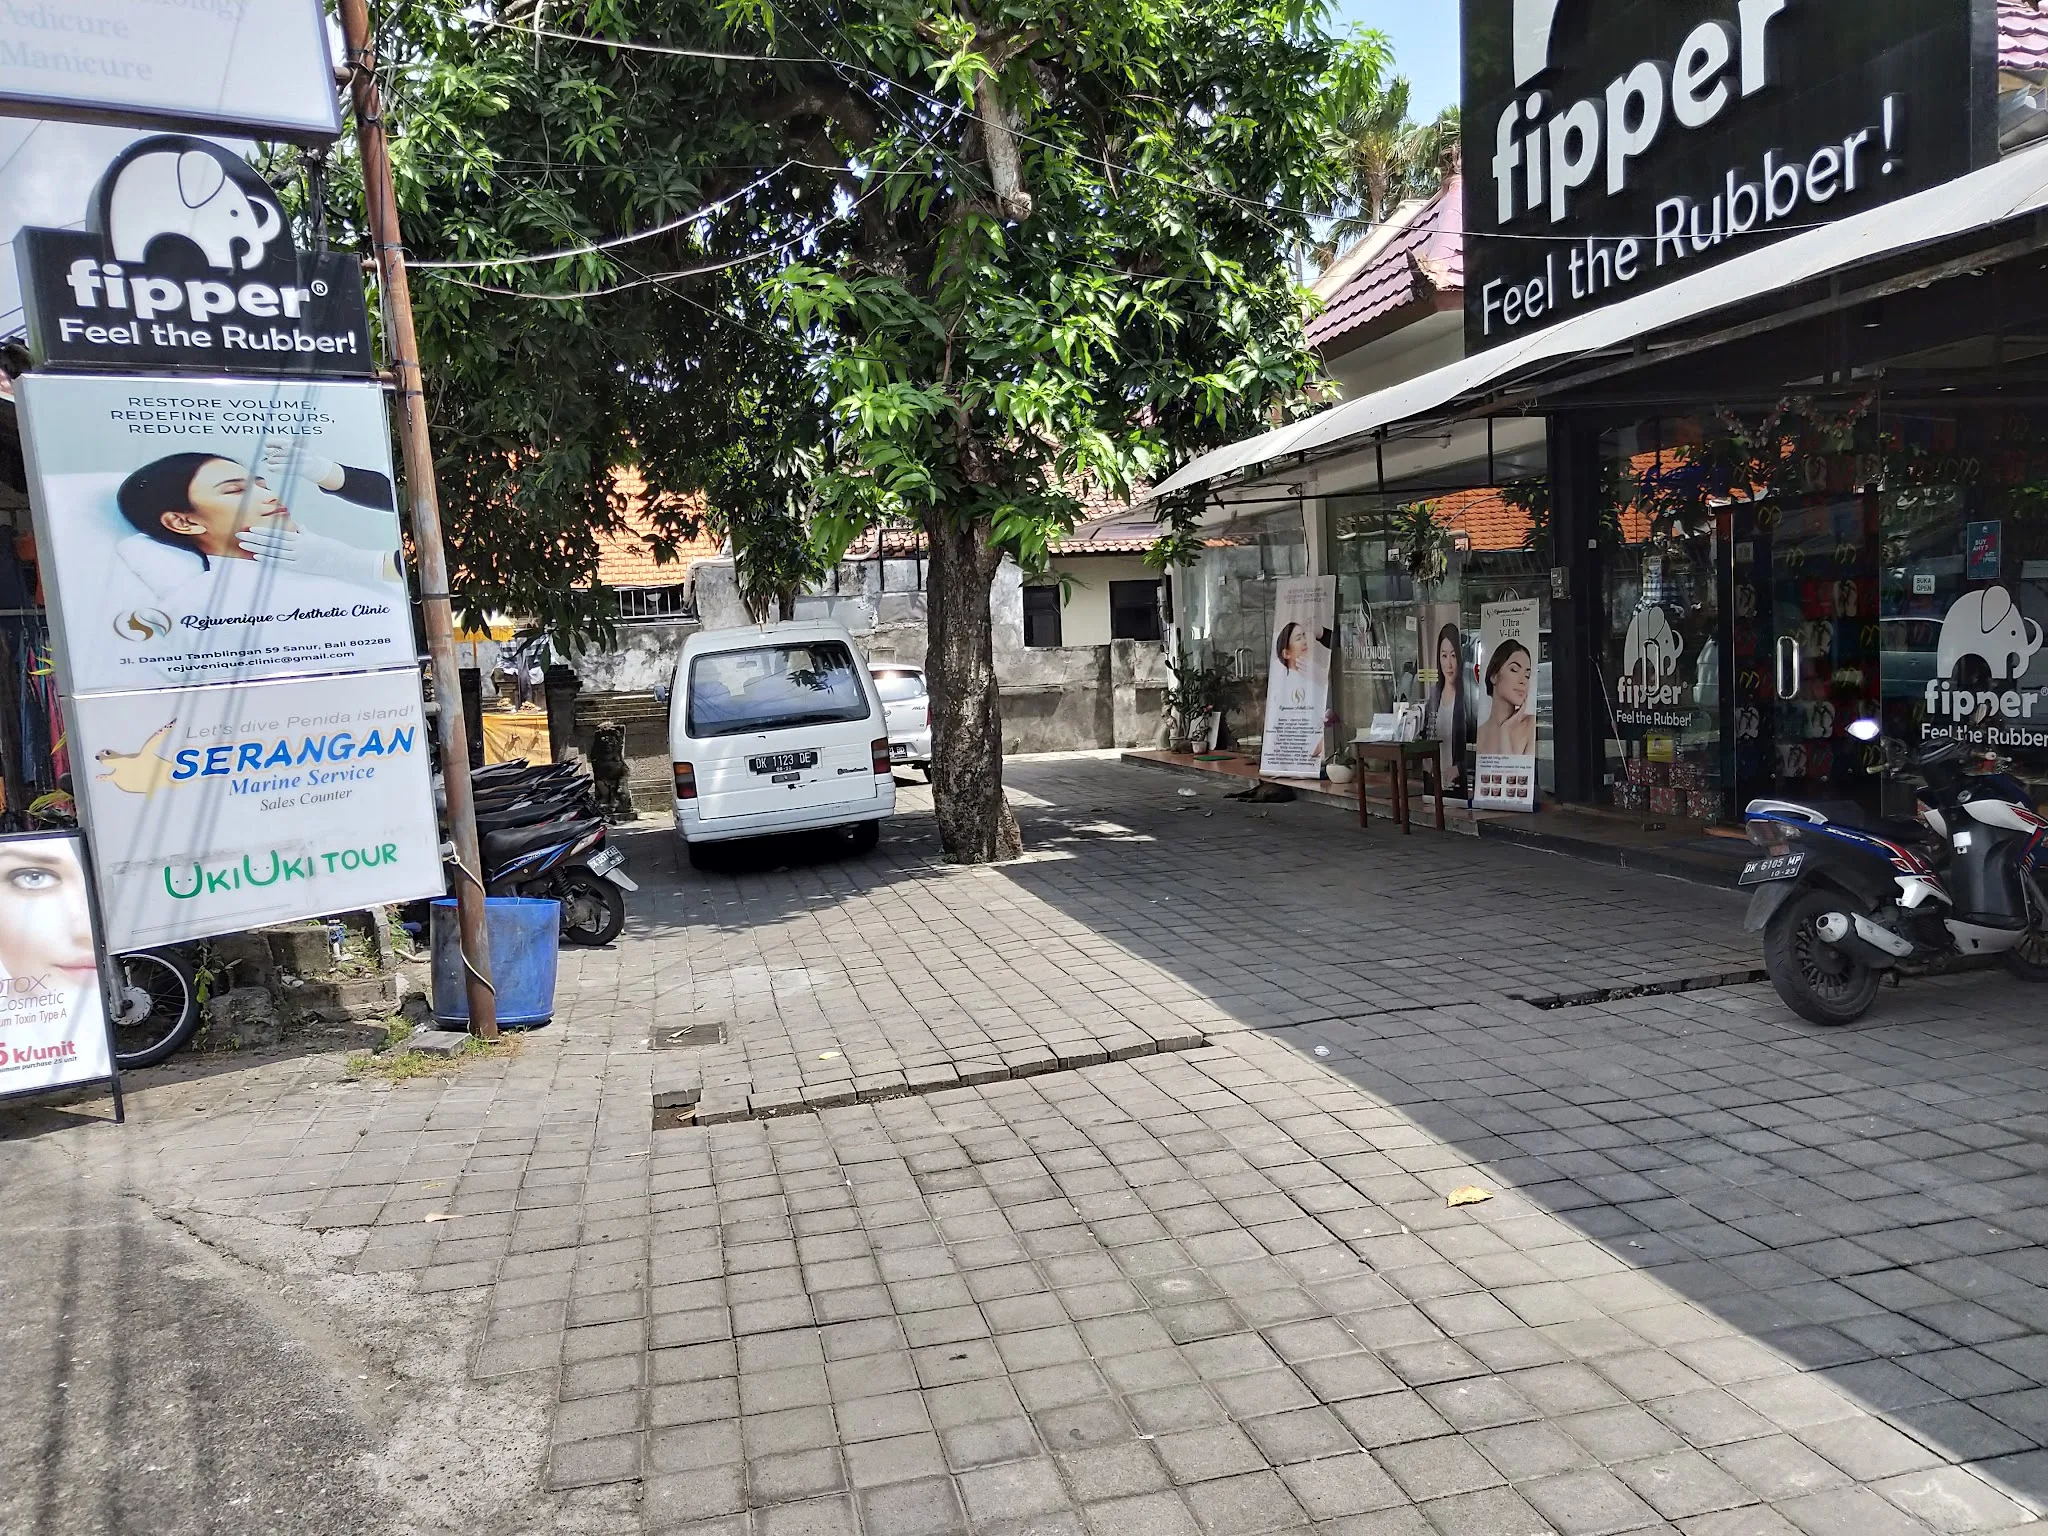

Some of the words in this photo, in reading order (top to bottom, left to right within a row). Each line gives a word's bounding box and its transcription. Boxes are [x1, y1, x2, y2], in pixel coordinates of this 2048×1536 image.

[1, 40, 153, 81] Manicure
[1492, 0, 1784, 223] fipper
[1482, 253, 1554, 336] Feel
[1568, 236, 1638, 295] the
[1655, 95, 1895, 267] Rubber!
[59, 318, 140, 345] Feel
[150, 323, 212, 349] the
[222, 326, 357, 354] Rubber!
[128, 397, 223, 409] RESTORE
[228, 399, 318, 412] VOLUME,
[110, 409, 216, 423] REDEFINE
[222, 411, 336, 425] CONTOURS,
[128, 423, 215, 436] REDUCE
[219, 425, 324, 437] WRINKLES
[1916, 577, 1932, 585] BUKA
[1916, 584, 1932, 592] OPEN
[180, 611, 275, 631] Rejuvenique
[276, 606, 349, 622] Aesthetic
[351, 603, 391, 617] Clinic
[1502, 618, 1520, 628] Ultra
[1499, 628, 1521, 638] V-Lift
[139, 654, 183, 664] Danau
[186, 647, 262, 663] Tamblingan
[265, 646, 280, 656] 59
[283, 643, 322, 654] Sanur,
[325, 640, 348, 650] Bali
[350, 636, 391, 647] 802288
[168, 649, 355, 673] rejuvenique.clinic@gmail.com
[186, 723, 234, 741] Let's
[240, 718, 279, 732] dive
[287, 711, 352, 730] Penida
[1616, 710, 1635, 724] Feel
[1636, 711, 1652, 725] the
[1653, 712, 1692, 727] Rubber!
[172, 725, 417, 781] SERANGAN
[755, 758, 767, 769] DK
[772, 754, 794, 767] 1123
[800, 751, 811, 764] DE
[228, 774, 301, 796] Marine
[307, 764, 376, 786] Service
[260, 796, 296, 812] Sales
[300, 786, 353, 807] Counter
[322, 843, 399, 875] TOUR
[1744, 862, 1758, 874] DK
[1760, 858, 1783, 871] 6105
[1787, 855, 1802, 866] MP
[1770, 868, 1796, 877] 10-23
[15, 1012, 36, 1025] Toxin
[39, 1010, 59, 1024] Type
[60, 1008, 68, 1018] A
[12, 1040, 77, 1064] k/unit
